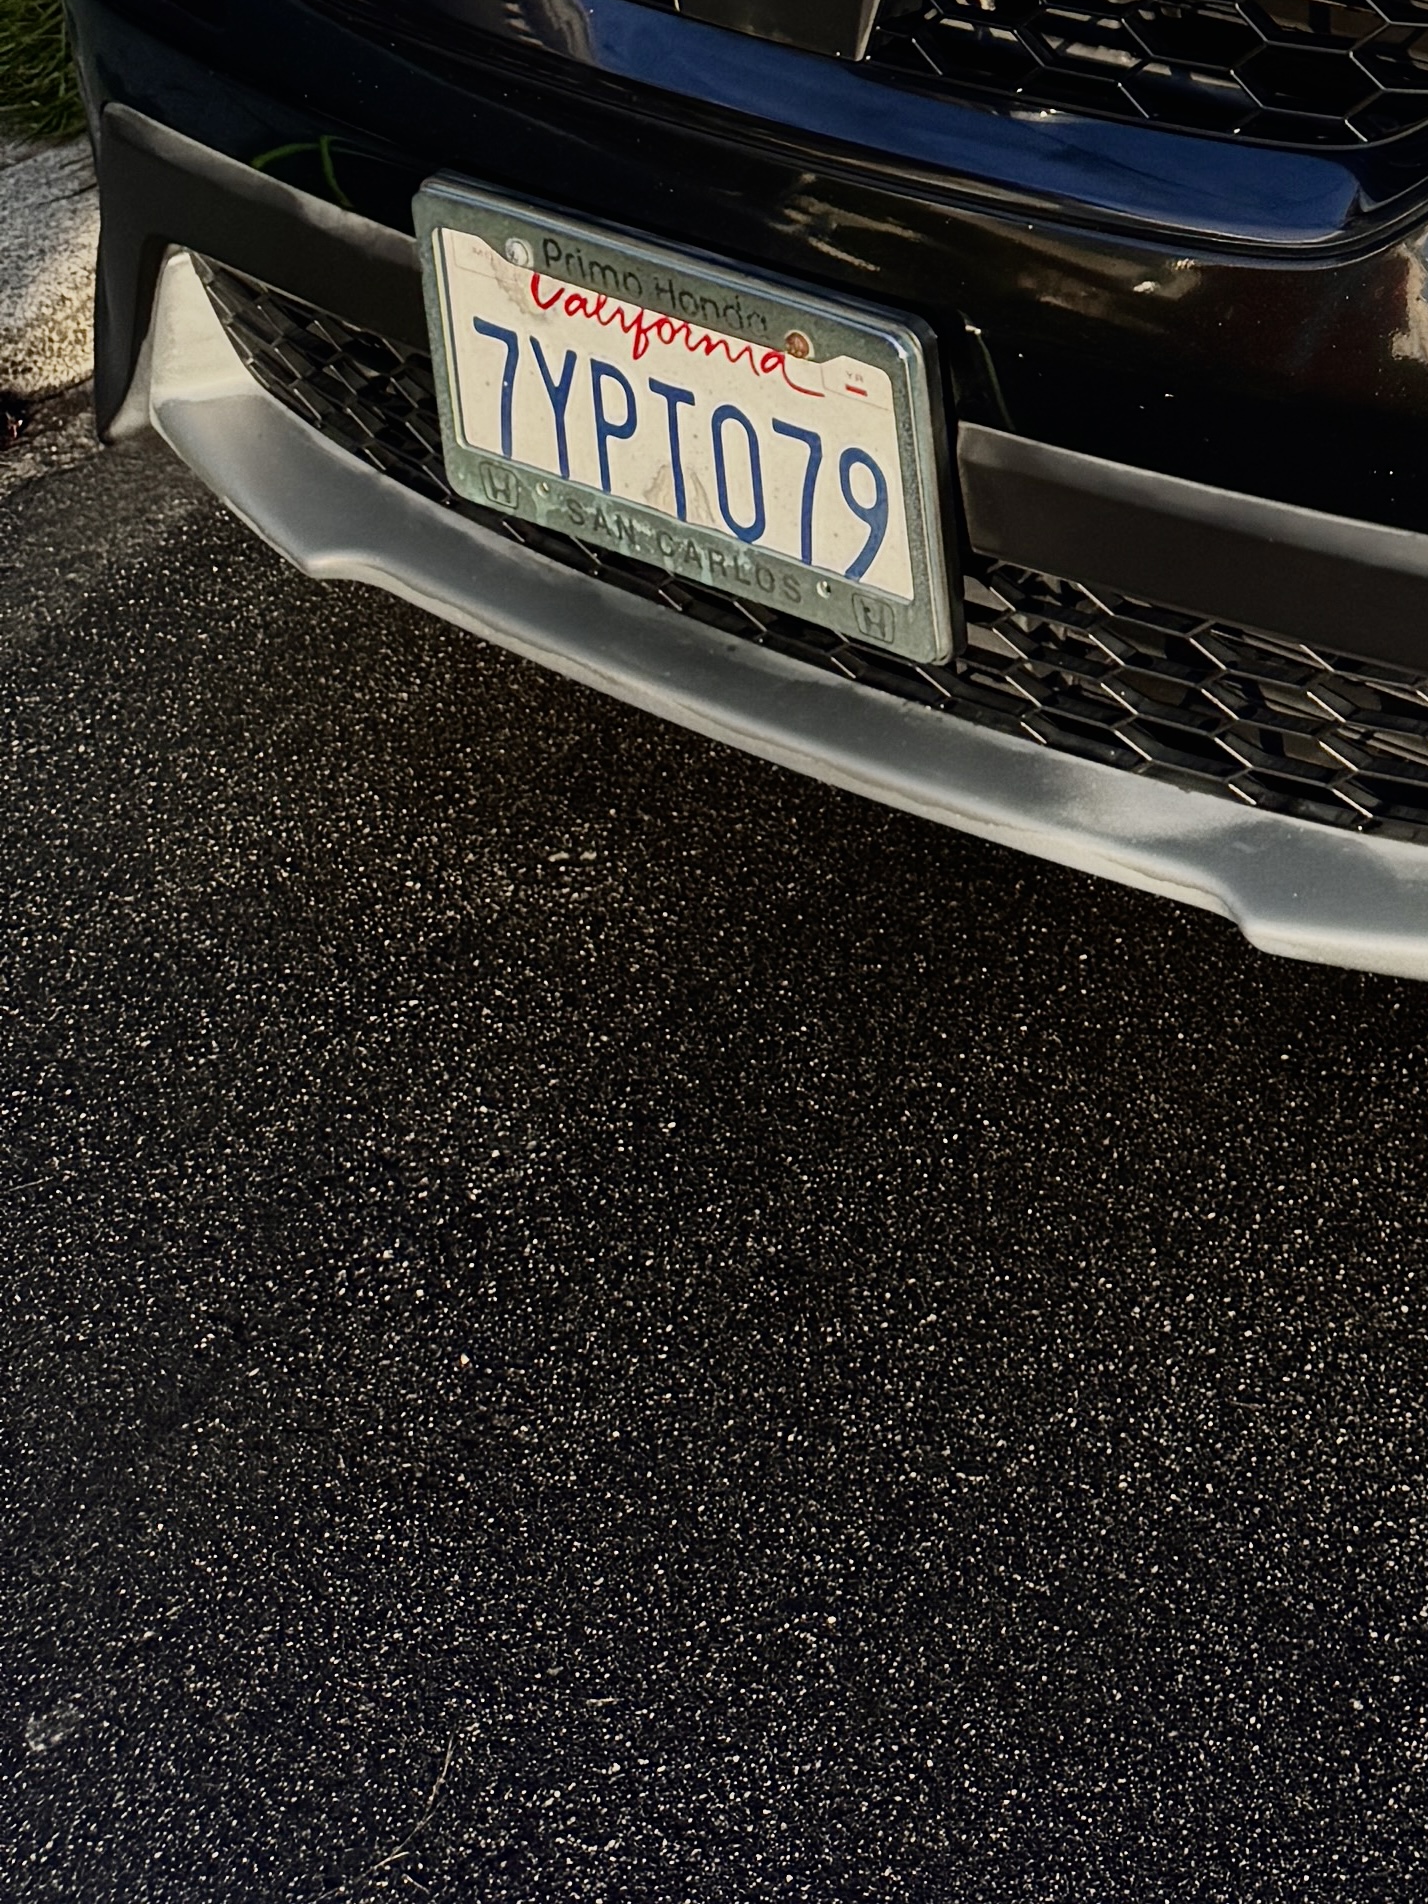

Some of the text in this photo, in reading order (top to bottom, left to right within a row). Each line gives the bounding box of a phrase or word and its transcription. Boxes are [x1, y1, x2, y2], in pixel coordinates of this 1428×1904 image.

[530, 272, 825, 398] California
[543, 238, 769, 333] Primo Honda
[473, 316, 888, 582] 7YPT079
[568, 500, 636, 544] SAN
[657, 532, 800, 604] CARLOS
